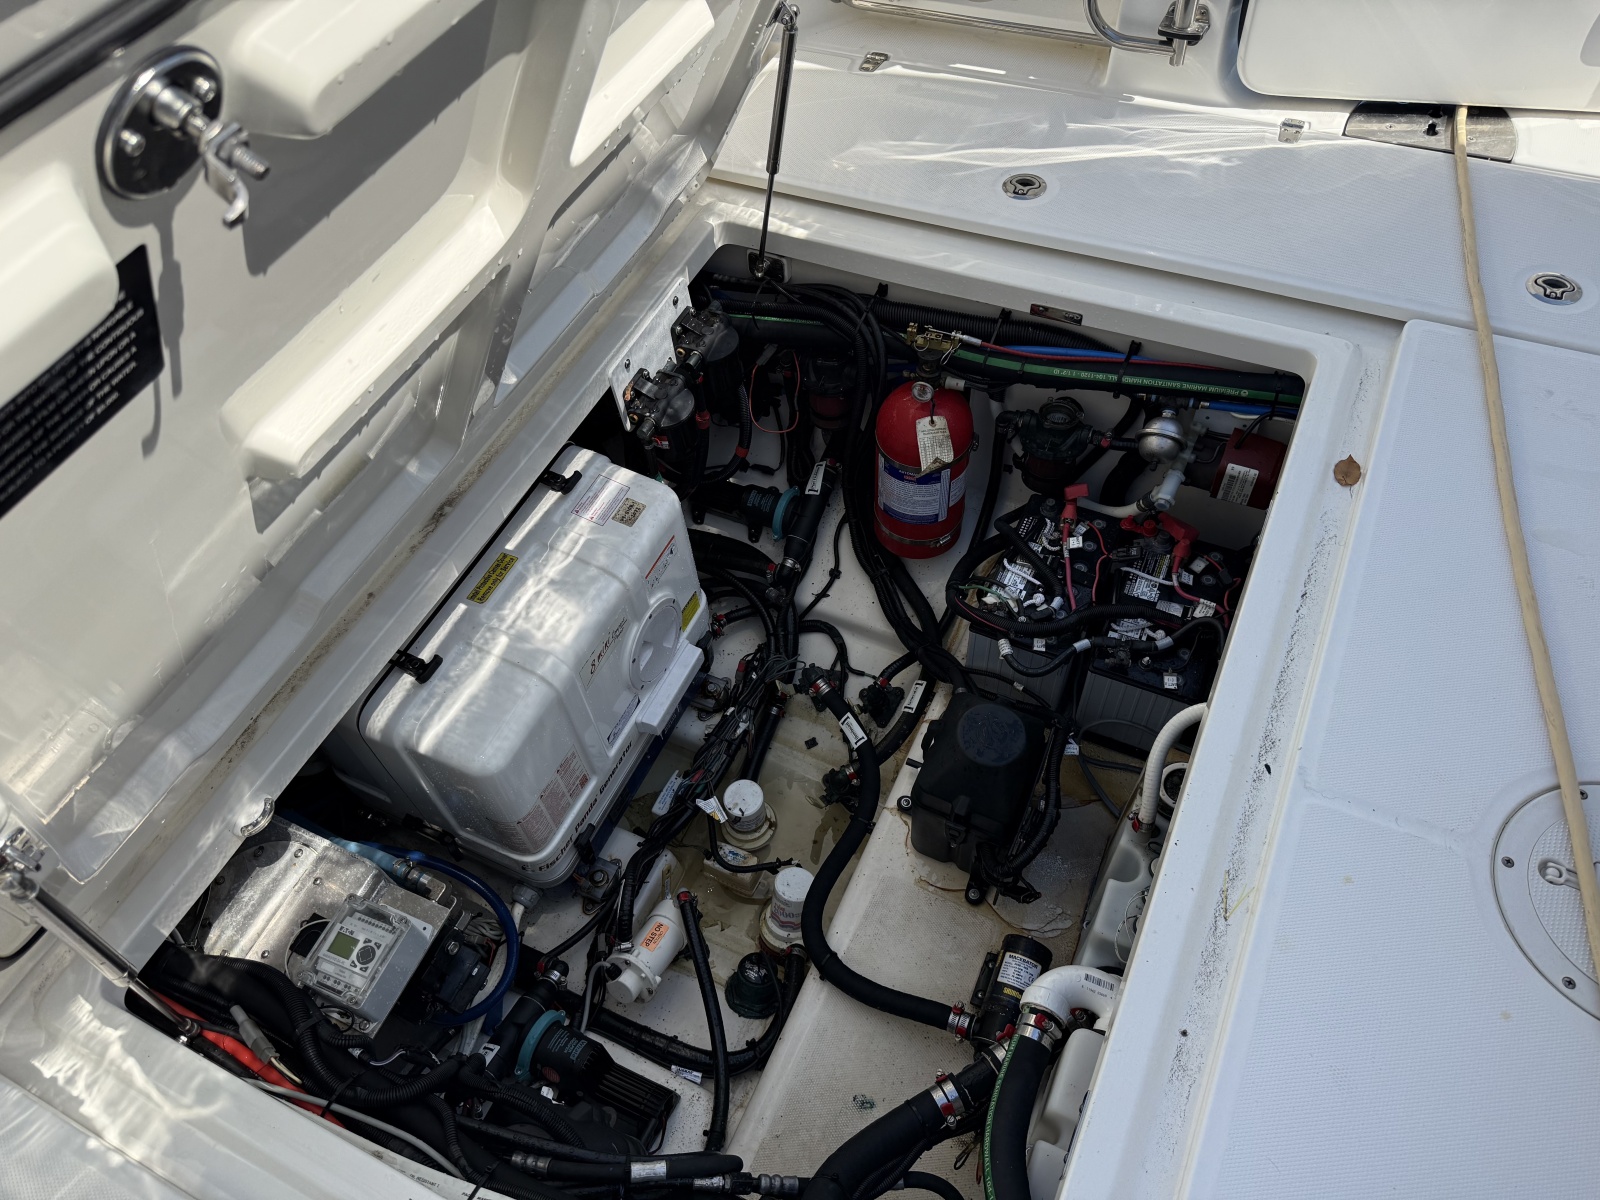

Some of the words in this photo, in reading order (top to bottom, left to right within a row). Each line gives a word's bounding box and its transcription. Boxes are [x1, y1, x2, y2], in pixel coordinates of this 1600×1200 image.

[89, 297, 134, 341] NAVIGABLE
[93, 306, 145, 355] CONTIGUOUS
[93, 346, 119, 371] UPON
[116, 335, 130, 351] OR
[128, 329, 137, 341] A
[87, 376, 102, 393] OR
[99, 350, 132, 381] CAUSES
[129, 344, 137, 355] A
[1142, 378, 1181, 388] SANITATION
[1182, 383, 1207, 391] MARINE
[1207, 386, 1239, 395] PREMIUM
[95, 383, 112, 400] THE
[82, 410, 96, 425] OF
[538, 834, 575, 872] Fischer
[574, 797, 598, 833] Panda
[598, 740, 634, 796] Generator
[338, 925, 354, 935] EATON
[654, 922, 663, 932] NO
[643, 931, 657, 947] STEP
[1008, 952, 1039, 969] MACERATOR
